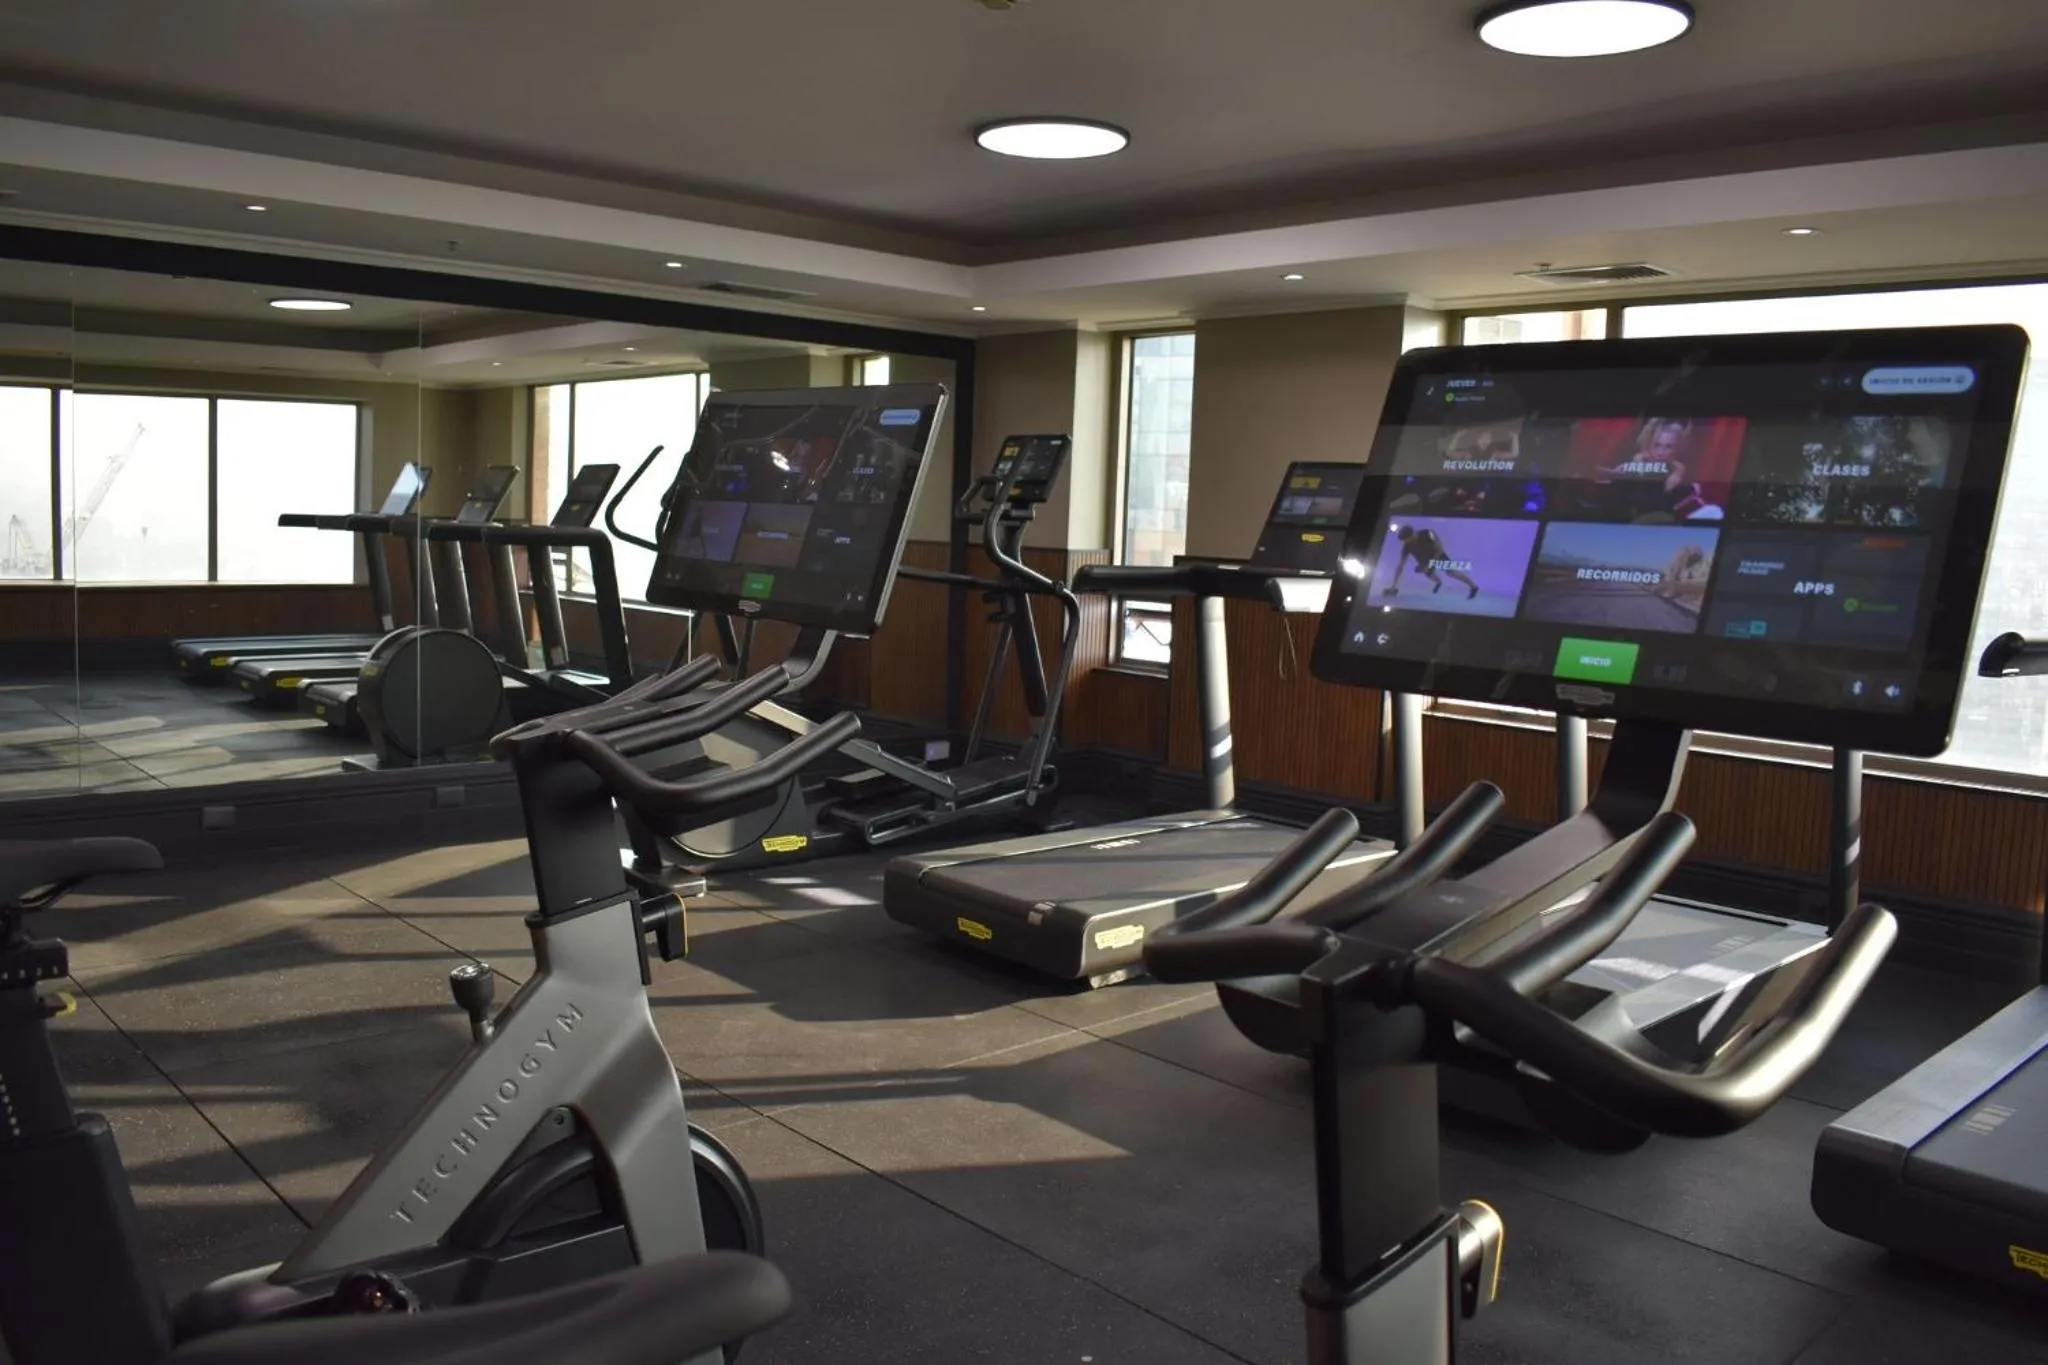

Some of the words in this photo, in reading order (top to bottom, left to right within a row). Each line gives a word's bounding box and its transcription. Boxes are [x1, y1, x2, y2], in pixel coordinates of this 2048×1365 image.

[1442, 459, 1515, 471] REVOLUTION
[1812, 462, 1870, 477] CLASES
[1428, 559, 1472, 571] FUERZA
[1576, 567, 1661, 584] RECORRIDOS
[1793, 581, 1835, 595] APPS
[389, 1002, 584, 1224] TECHNOGYM
